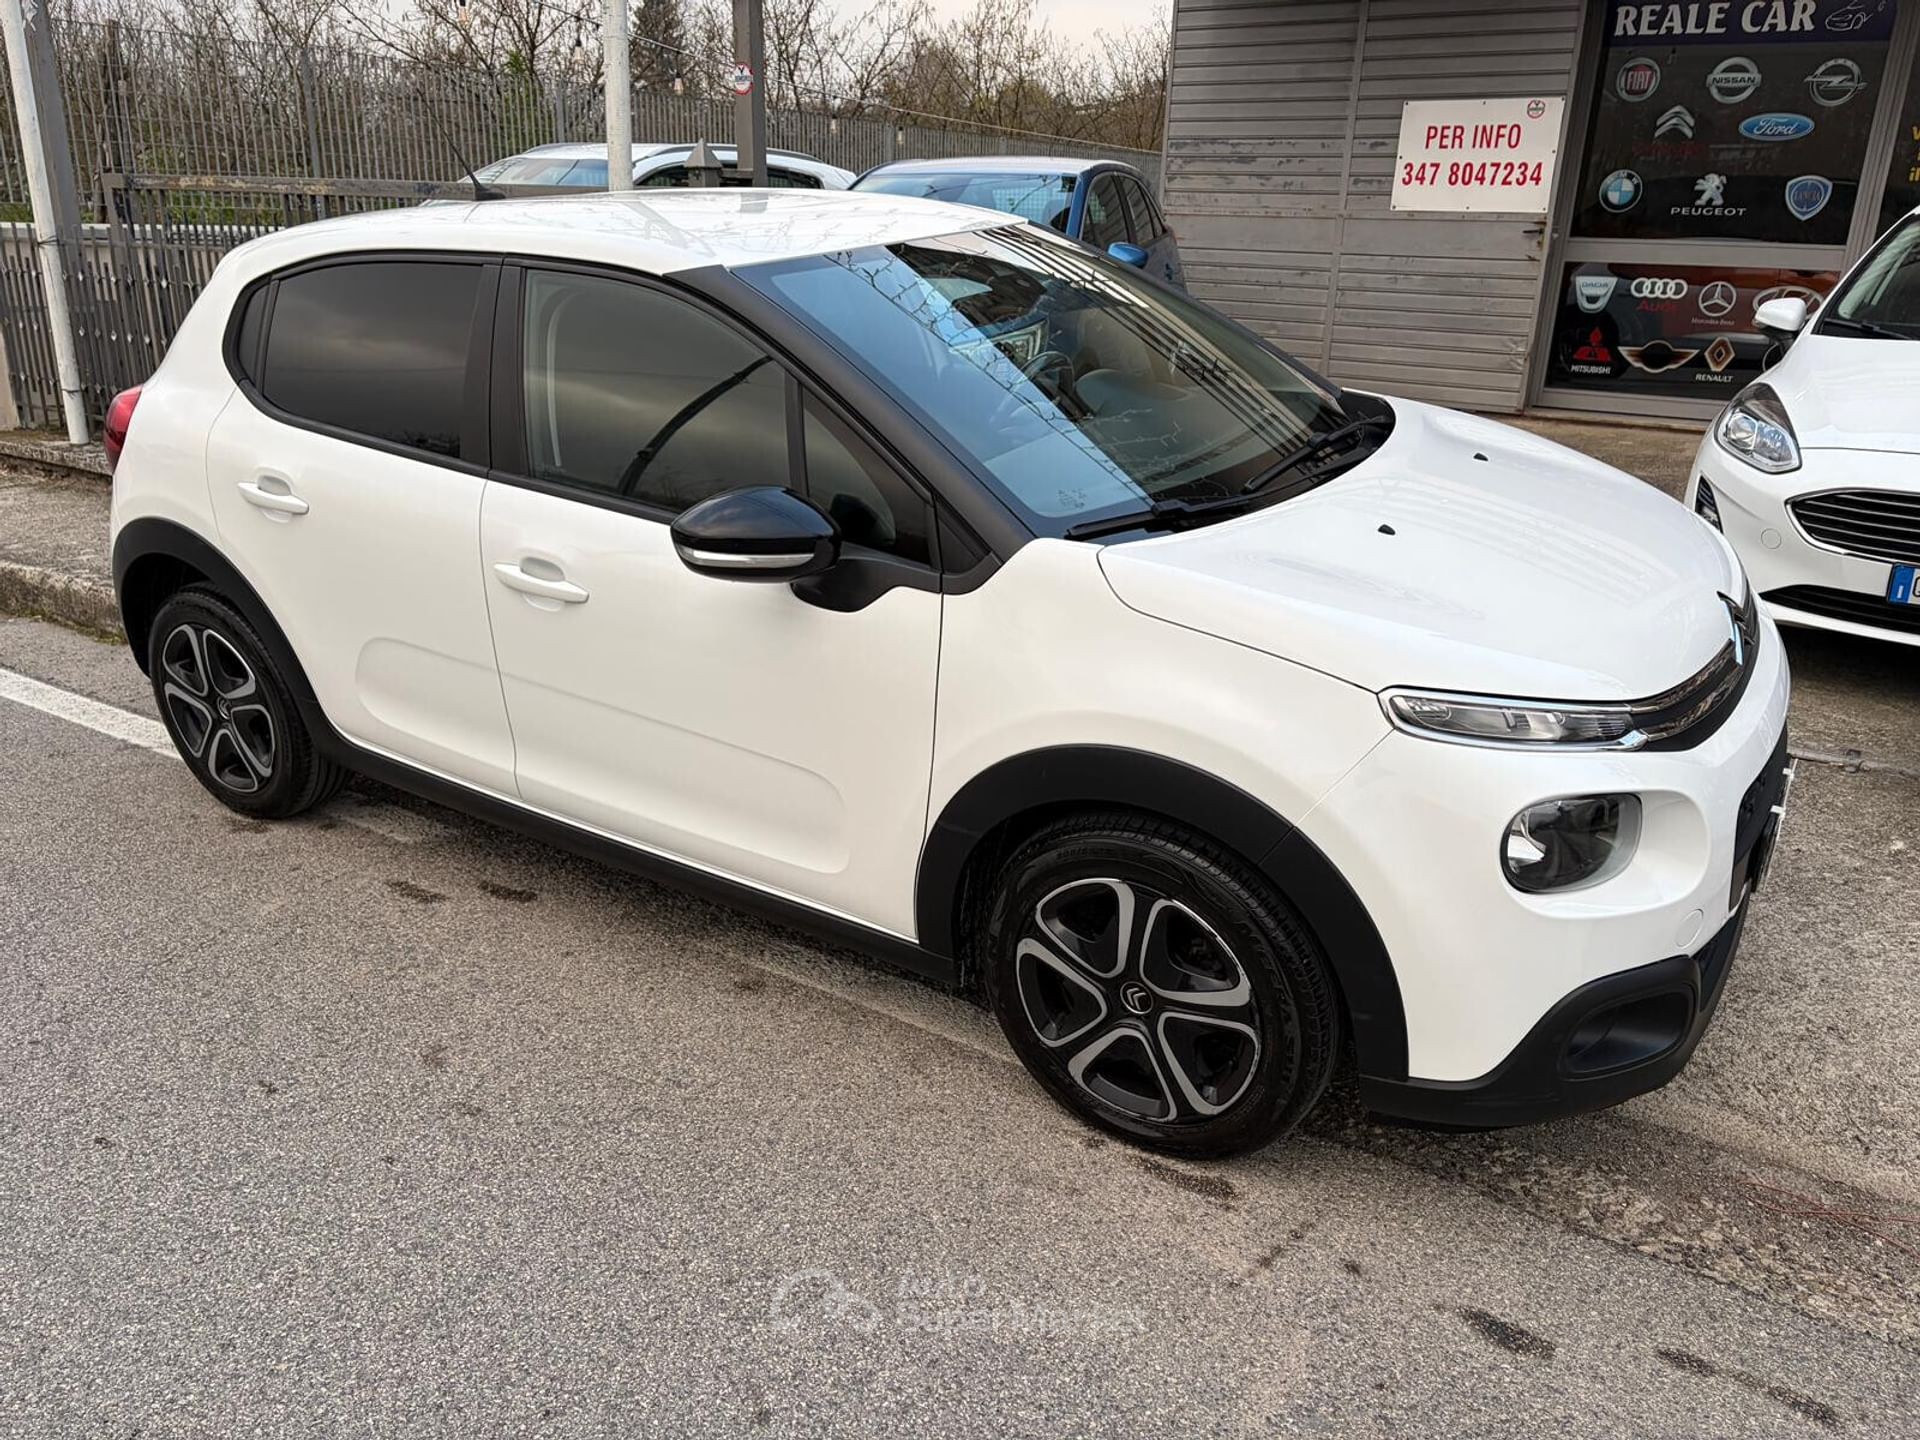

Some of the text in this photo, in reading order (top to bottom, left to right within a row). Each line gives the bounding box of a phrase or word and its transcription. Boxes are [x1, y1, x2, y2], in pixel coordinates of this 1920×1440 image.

[1614, 0, 1817, 37] REALE CAR
[1626, 70, 1652, 91] FIAT
[1711, 76, 1757, 86] NISSAN
[1752, 118, 1799, 136] Ford
[1425, 124, 1522, 149] PER INFO
[1402, 162, 1543, 186] 347 8047234
[1670, 206, 1747, 217] PEUGEOT
[1571, 364, 1611, 375] MITSUBISHI
[1696, 373, 1733, 383] RENAULT
